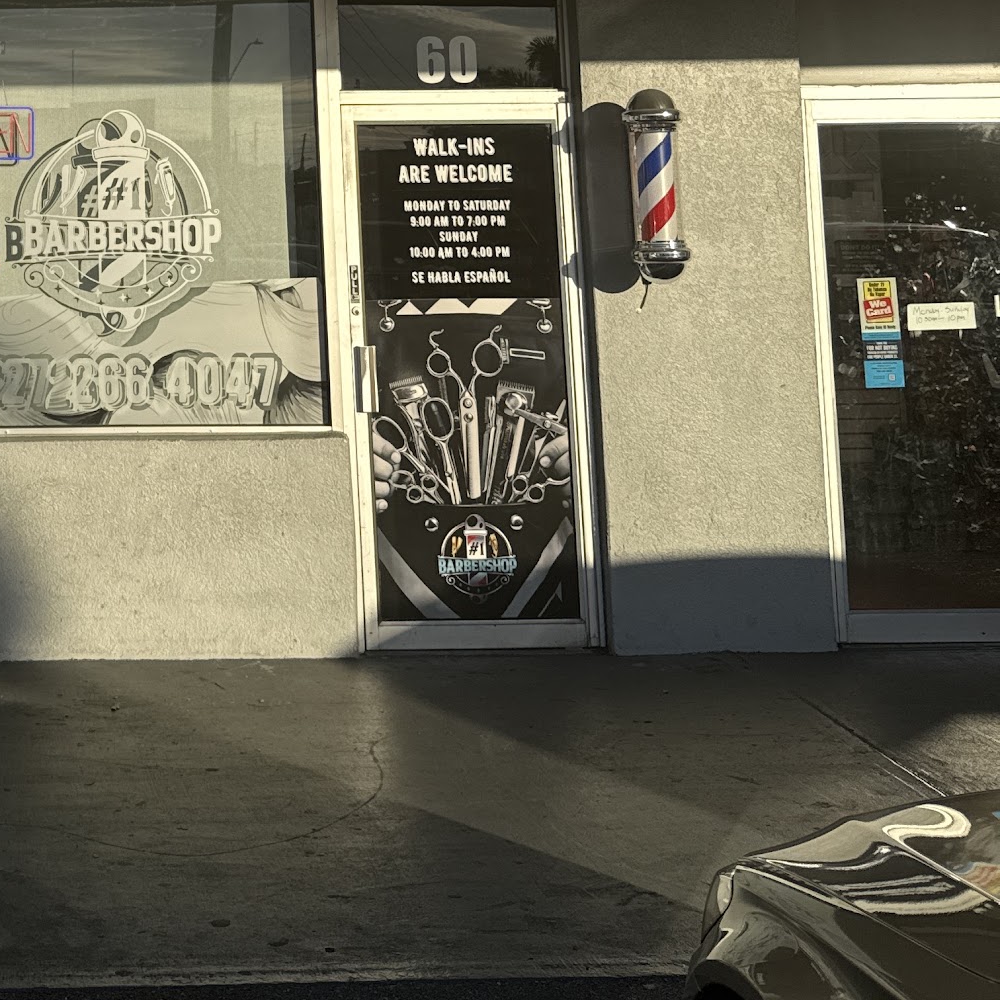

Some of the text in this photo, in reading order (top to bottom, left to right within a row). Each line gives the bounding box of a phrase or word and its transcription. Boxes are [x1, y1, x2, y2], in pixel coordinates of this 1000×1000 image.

[416, 35, 478, 84] 60
[413, 137, 496, 157] WALK-INS
[398, 164, 514, 184] ARE WELCOME
[403, 199, 511, 212] MONDAY TO SATURDAY
[409, 215, 506, 227] 9:00 AM TO 7:00 PM
[24, 216, 223, 256] BARBERSHOP
[439, 231, 479, 242] SUNDAY
[409, 246, 511, 259] 10:00 AM TO 4:00 PM
[350, 265, 359, 295] PULL
[412, 268, 511, 283] SE HABLA ESPAÑOL
[866, 305, 892, 317] Card
[868, 299, 887, 309] We
[912, 306, 940, 316] Monday
[944, 305, 970, 315] Sunday
[69, 355, 153, 410] 266
[165, 355, 280, 409] 4047
[468, 541, 485, 556] #1
[439, 558, 518, 574] BARBERSHOP
